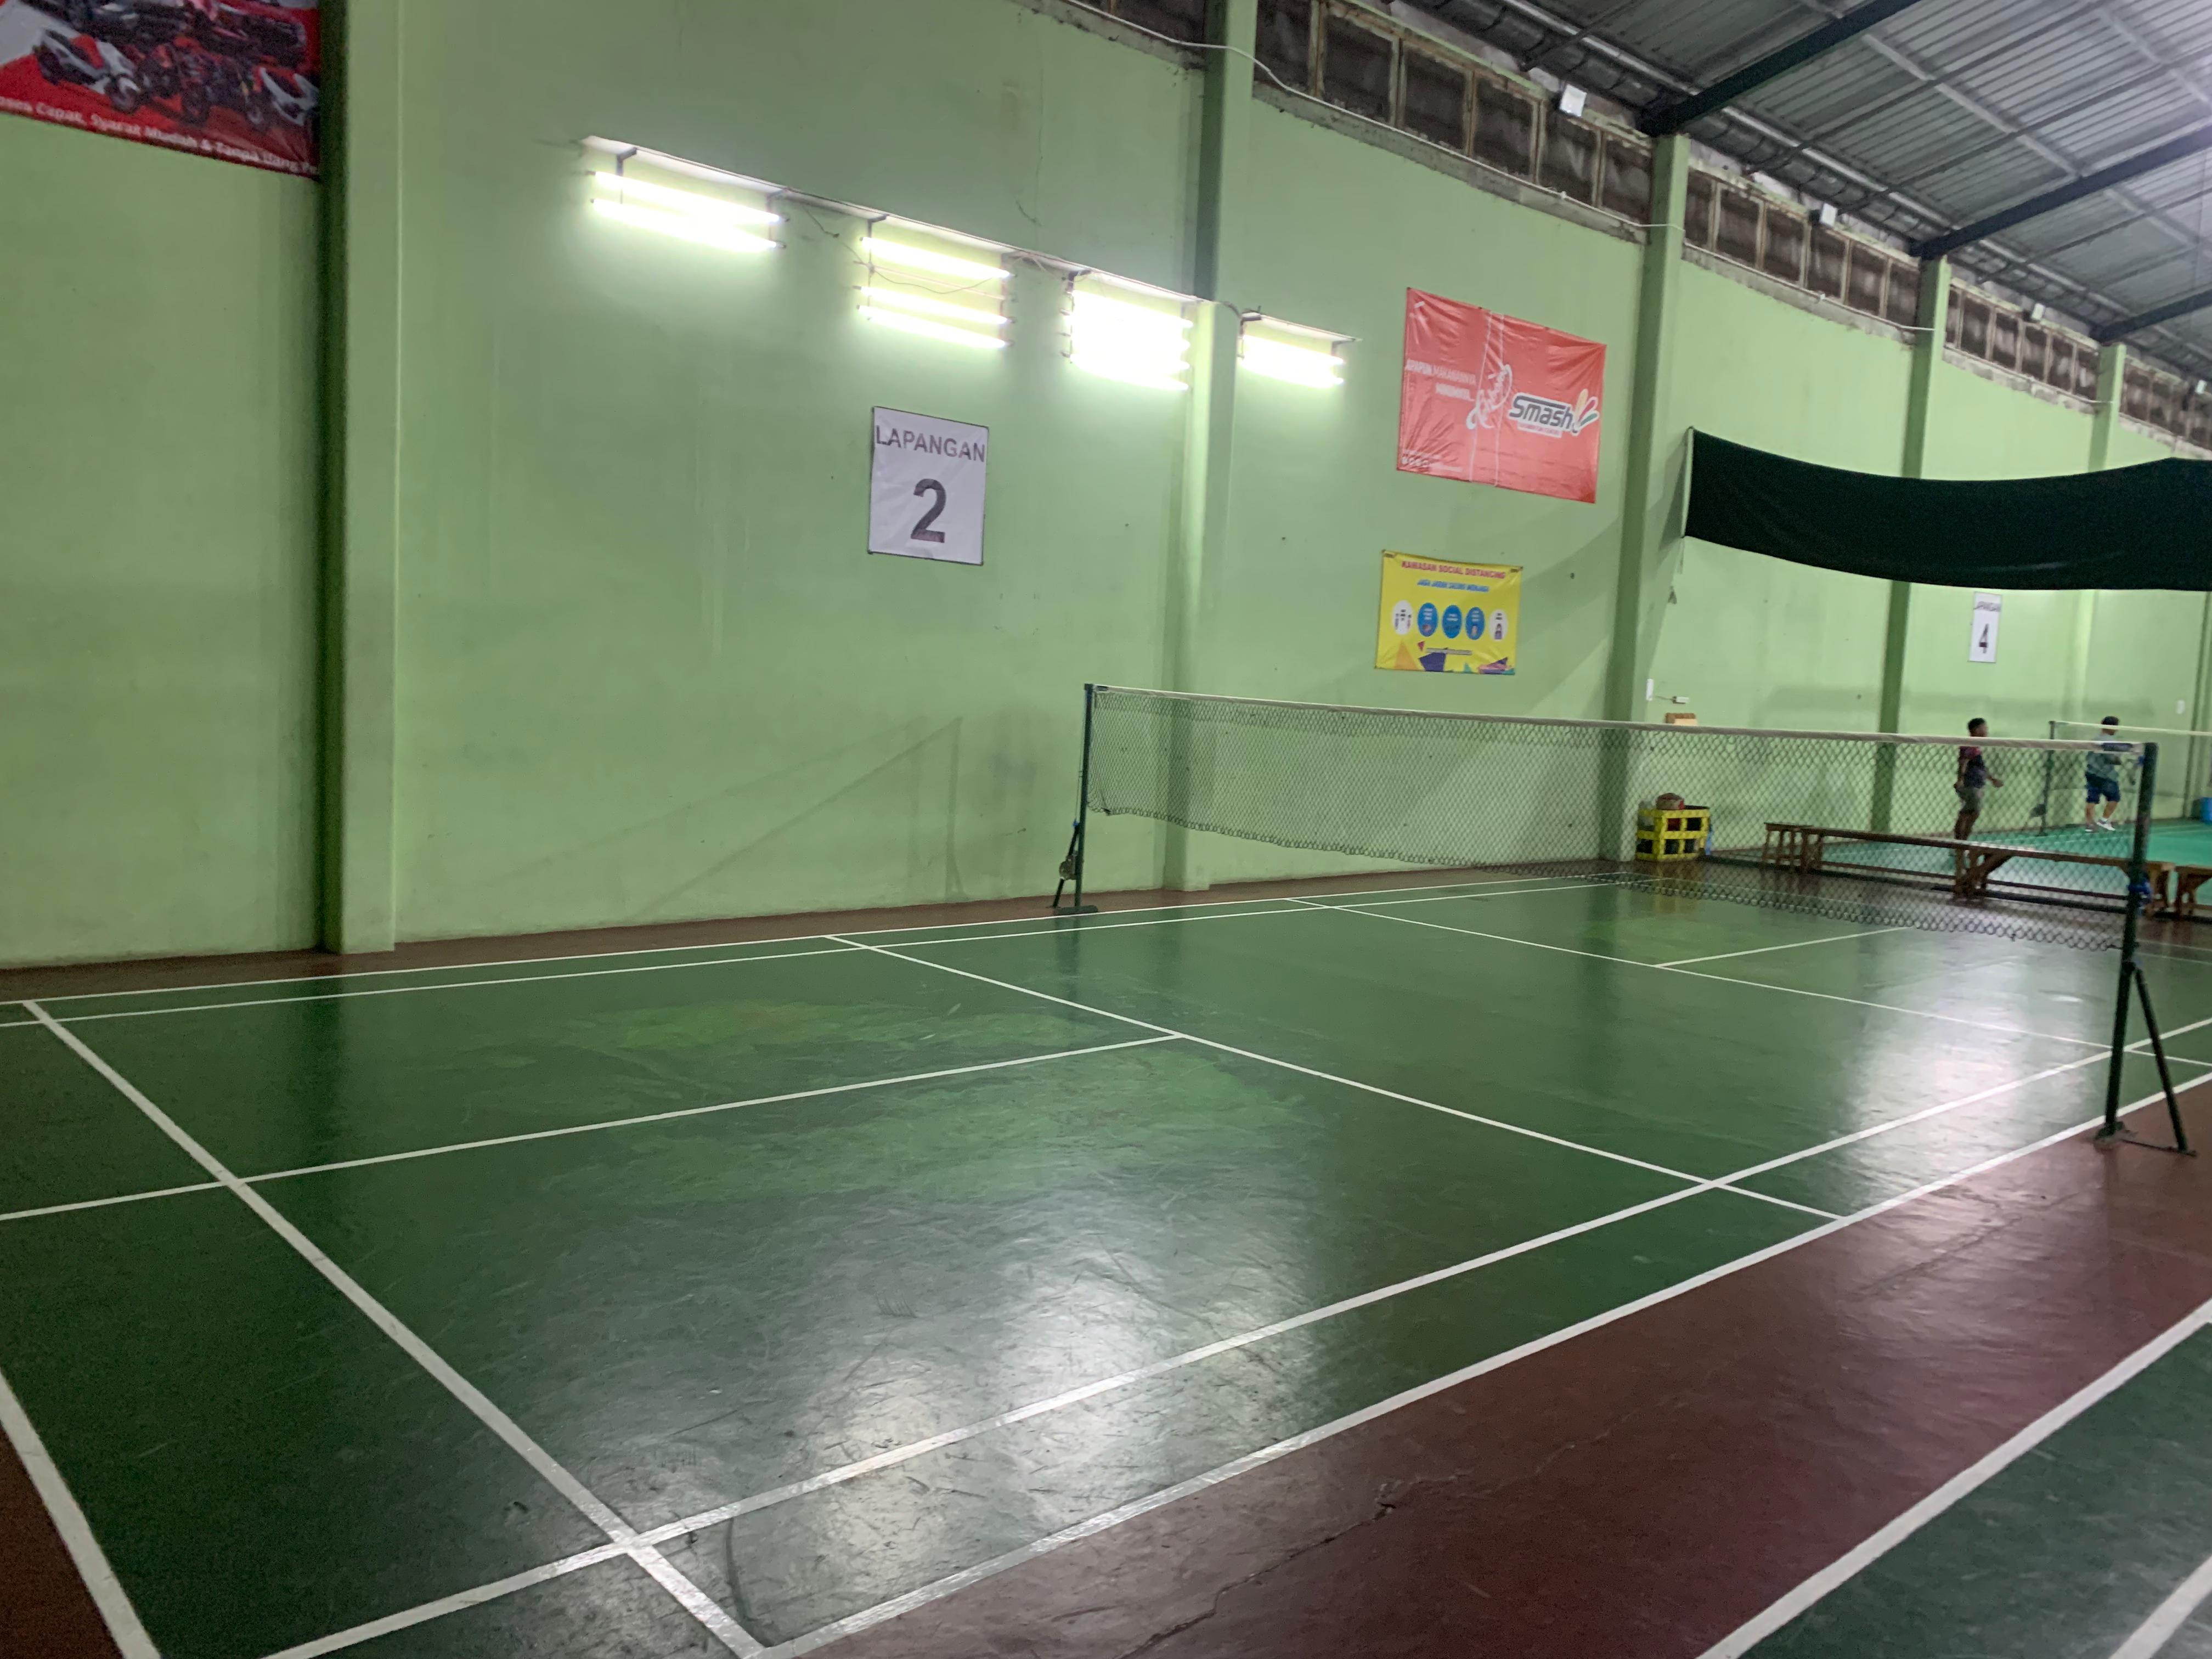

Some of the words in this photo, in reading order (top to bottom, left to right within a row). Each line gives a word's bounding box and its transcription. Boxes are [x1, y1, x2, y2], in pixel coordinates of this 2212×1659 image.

[91, 113, 141, 136] Syarat
[876, 425, 985, 462] LAPANGAN
[910, 478, 946, 543] 2
[1438, 565, 1464, 574] SOCIAL
[1465, 568, 1506, 579] DISTANCING
[1978, 623, 1989, 654] 4
